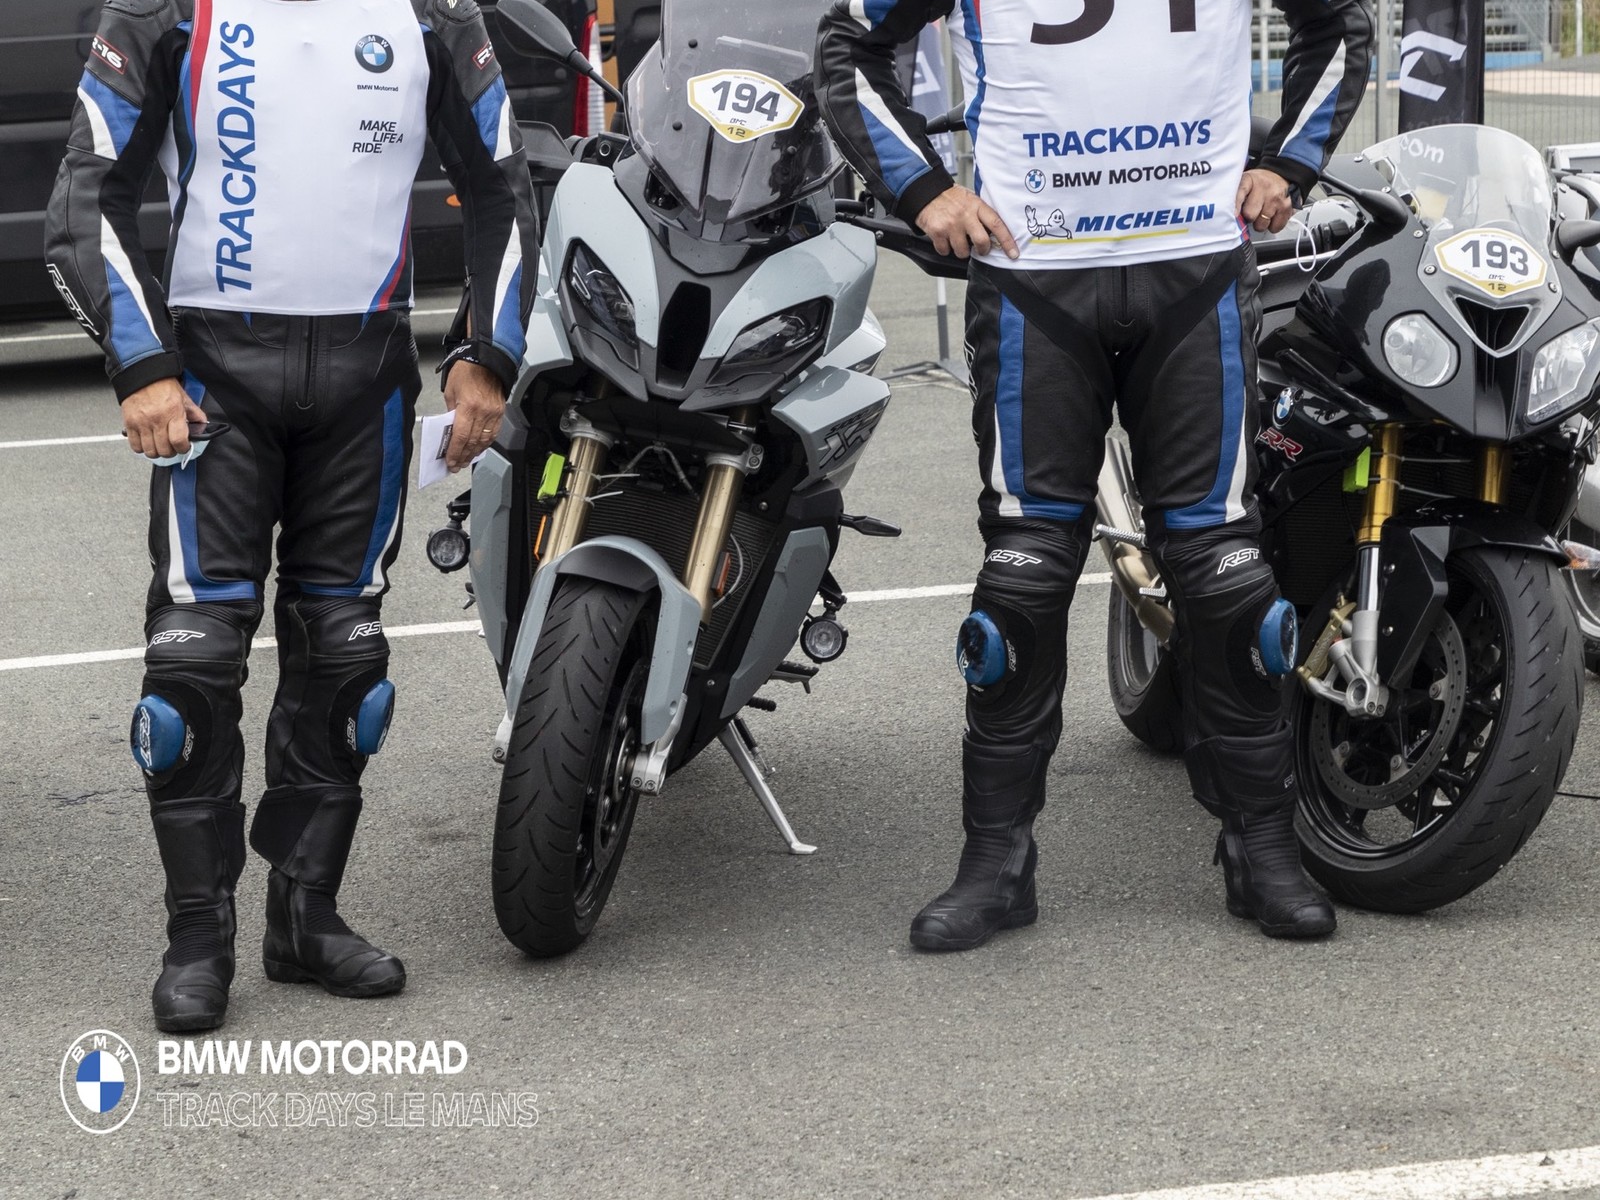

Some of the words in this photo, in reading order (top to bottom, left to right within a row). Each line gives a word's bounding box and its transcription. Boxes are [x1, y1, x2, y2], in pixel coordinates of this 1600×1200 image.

[712, 81, 780, 122] 194
[359, 120, 397, 133] MAKE
[727, 127, 746, 138] 12
[352, 142, 383, 154] RIDE.
[372, 132, 395, 144] LIFE
[396, 133, 404, 144] A
[1023, 119, 1211, 158] TRACKDAYS
[215, 20, 257, 293] TRACKDAYS
[1052, 171, 1102, 188] BMW
[1109, 160, 1212, 185] MOTORRAD
[1075, 203, 1216, 233] MICHELIN
[1461, 240, 1529, 276] 193
[1488, 283, 1507, 292] 12
[985, 549, 1042, 567] RST
[1217, 548, 1259, 575] RST
[148, 629, 206, 648] RST
[348, 621, 383, 641] RS
